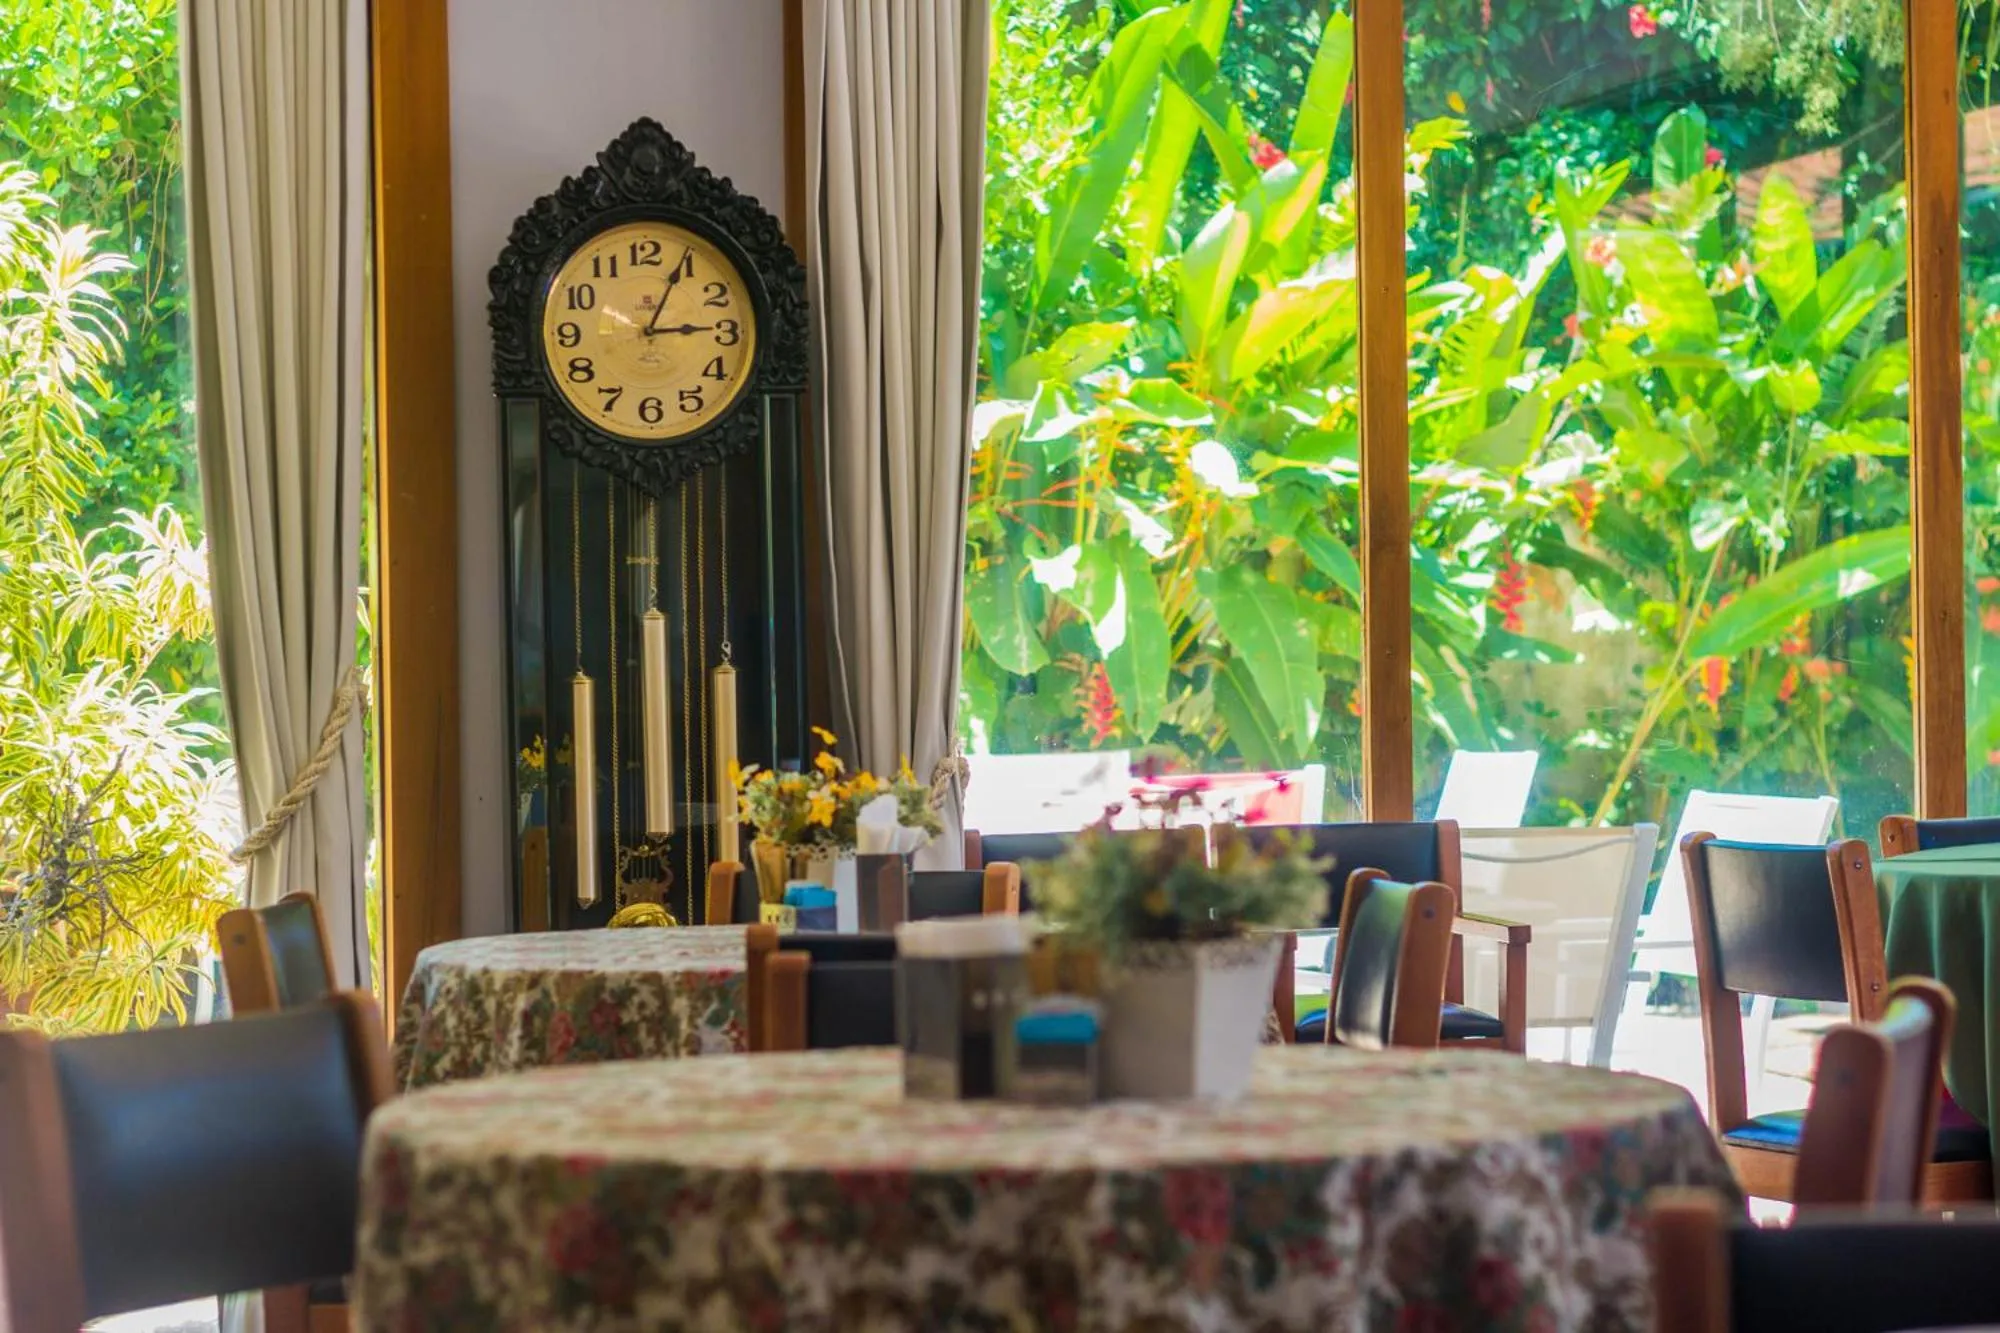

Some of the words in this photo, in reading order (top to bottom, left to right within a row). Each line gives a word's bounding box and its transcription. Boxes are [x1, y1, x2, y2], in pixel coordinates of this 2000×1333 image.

[592, 254, 618, 278] 11
[629, 240, 662, 266] 12
[567, 283, 595, 310] 10
[703, 282, 729, 307] 2
[557, 322, 581, 347] 9
[715, 319, 739, 345] 3
[568, 357, 595, 383] 8
[702, 356, 728, 381] 4
[598, 385, 623, 412] 7
[638, 397, 664, 424] 6
[679, 385, 704, 413] 5
